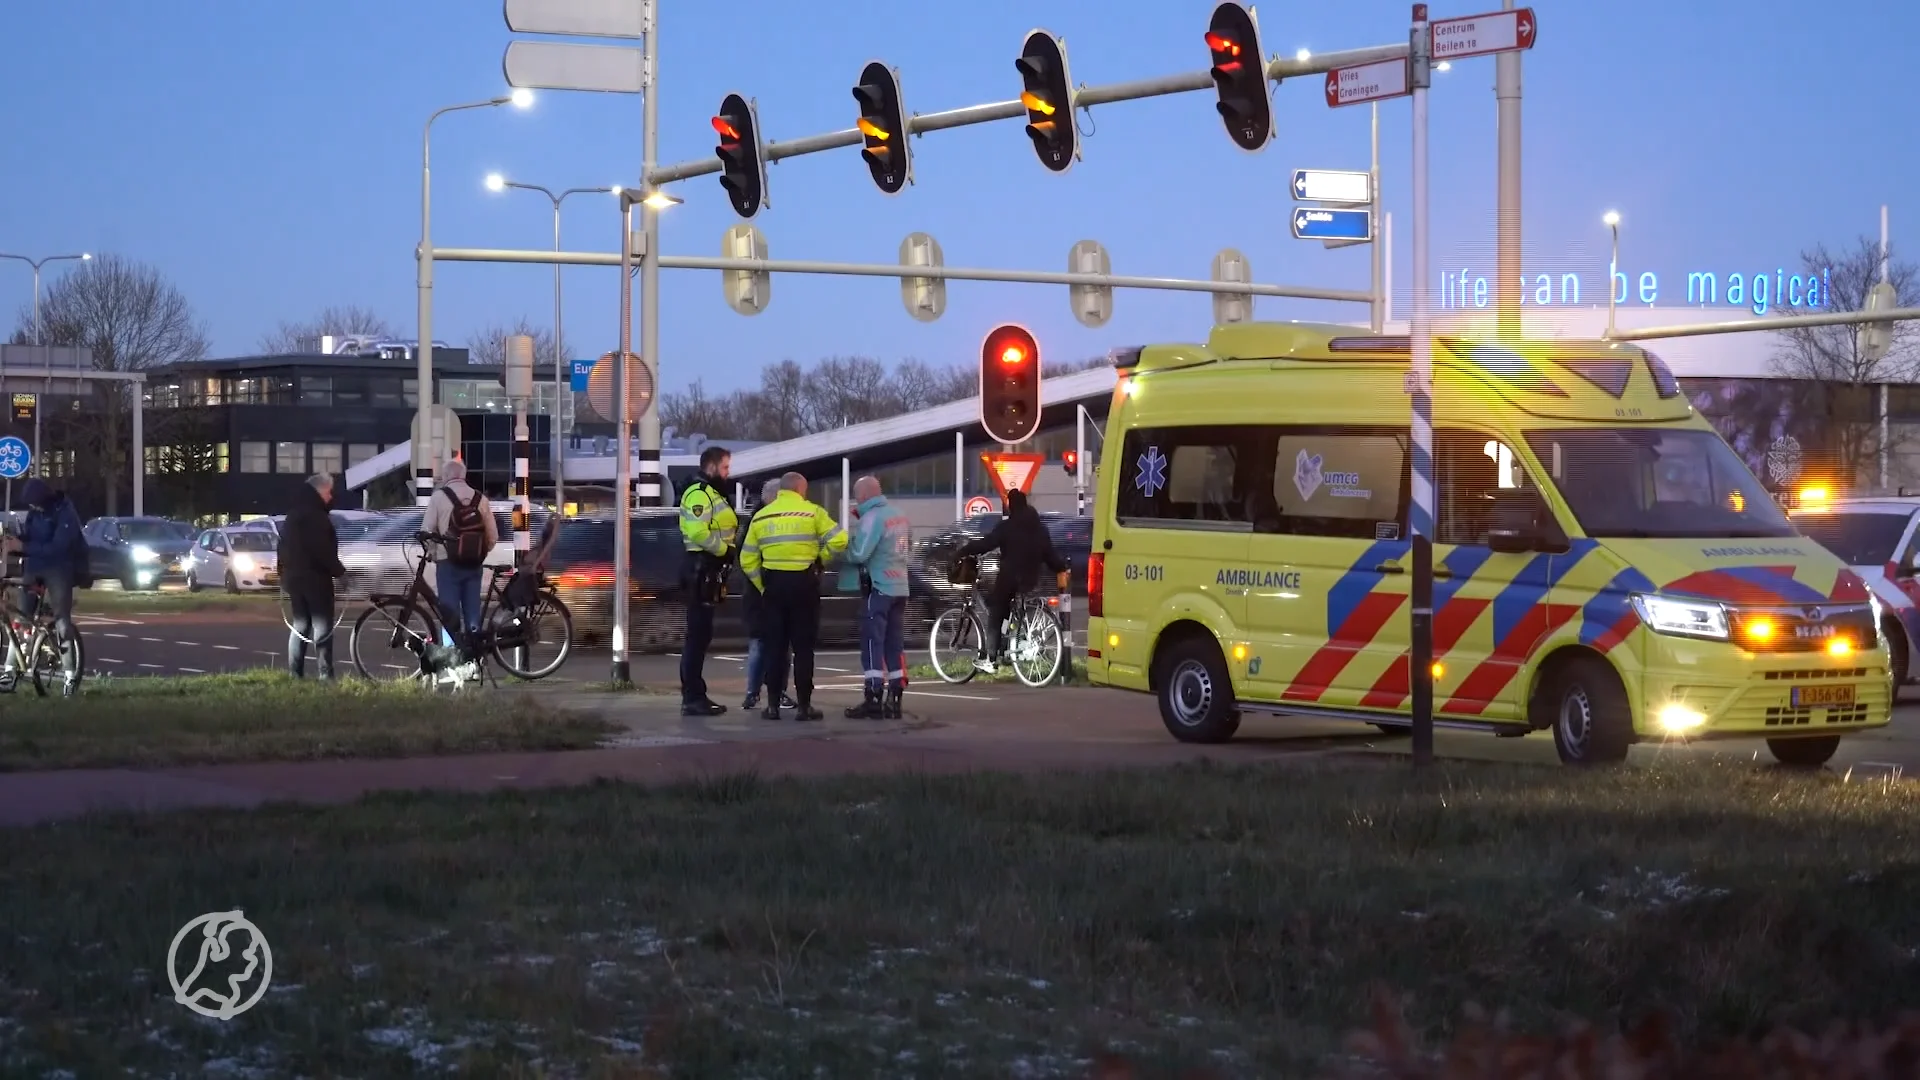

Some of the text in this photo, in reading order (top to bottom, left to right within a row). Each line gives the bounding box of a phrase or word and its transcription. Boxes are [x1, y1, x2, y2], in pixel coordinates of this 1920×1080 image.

[1435, 23, 1475, 36] Centrum
[1435, 40, 1477, 53] Beilen 18
[1340, 71, 1359, 82] Vries
[1339, 84, 1379, 98] Groningen
[1441, 268, 1488, 308] life
[1687, 267, 1830, 315] magical
[1125, 564, 1163, 581] 03-101
[1216, 569, 1300, 589] AMBULANCE
